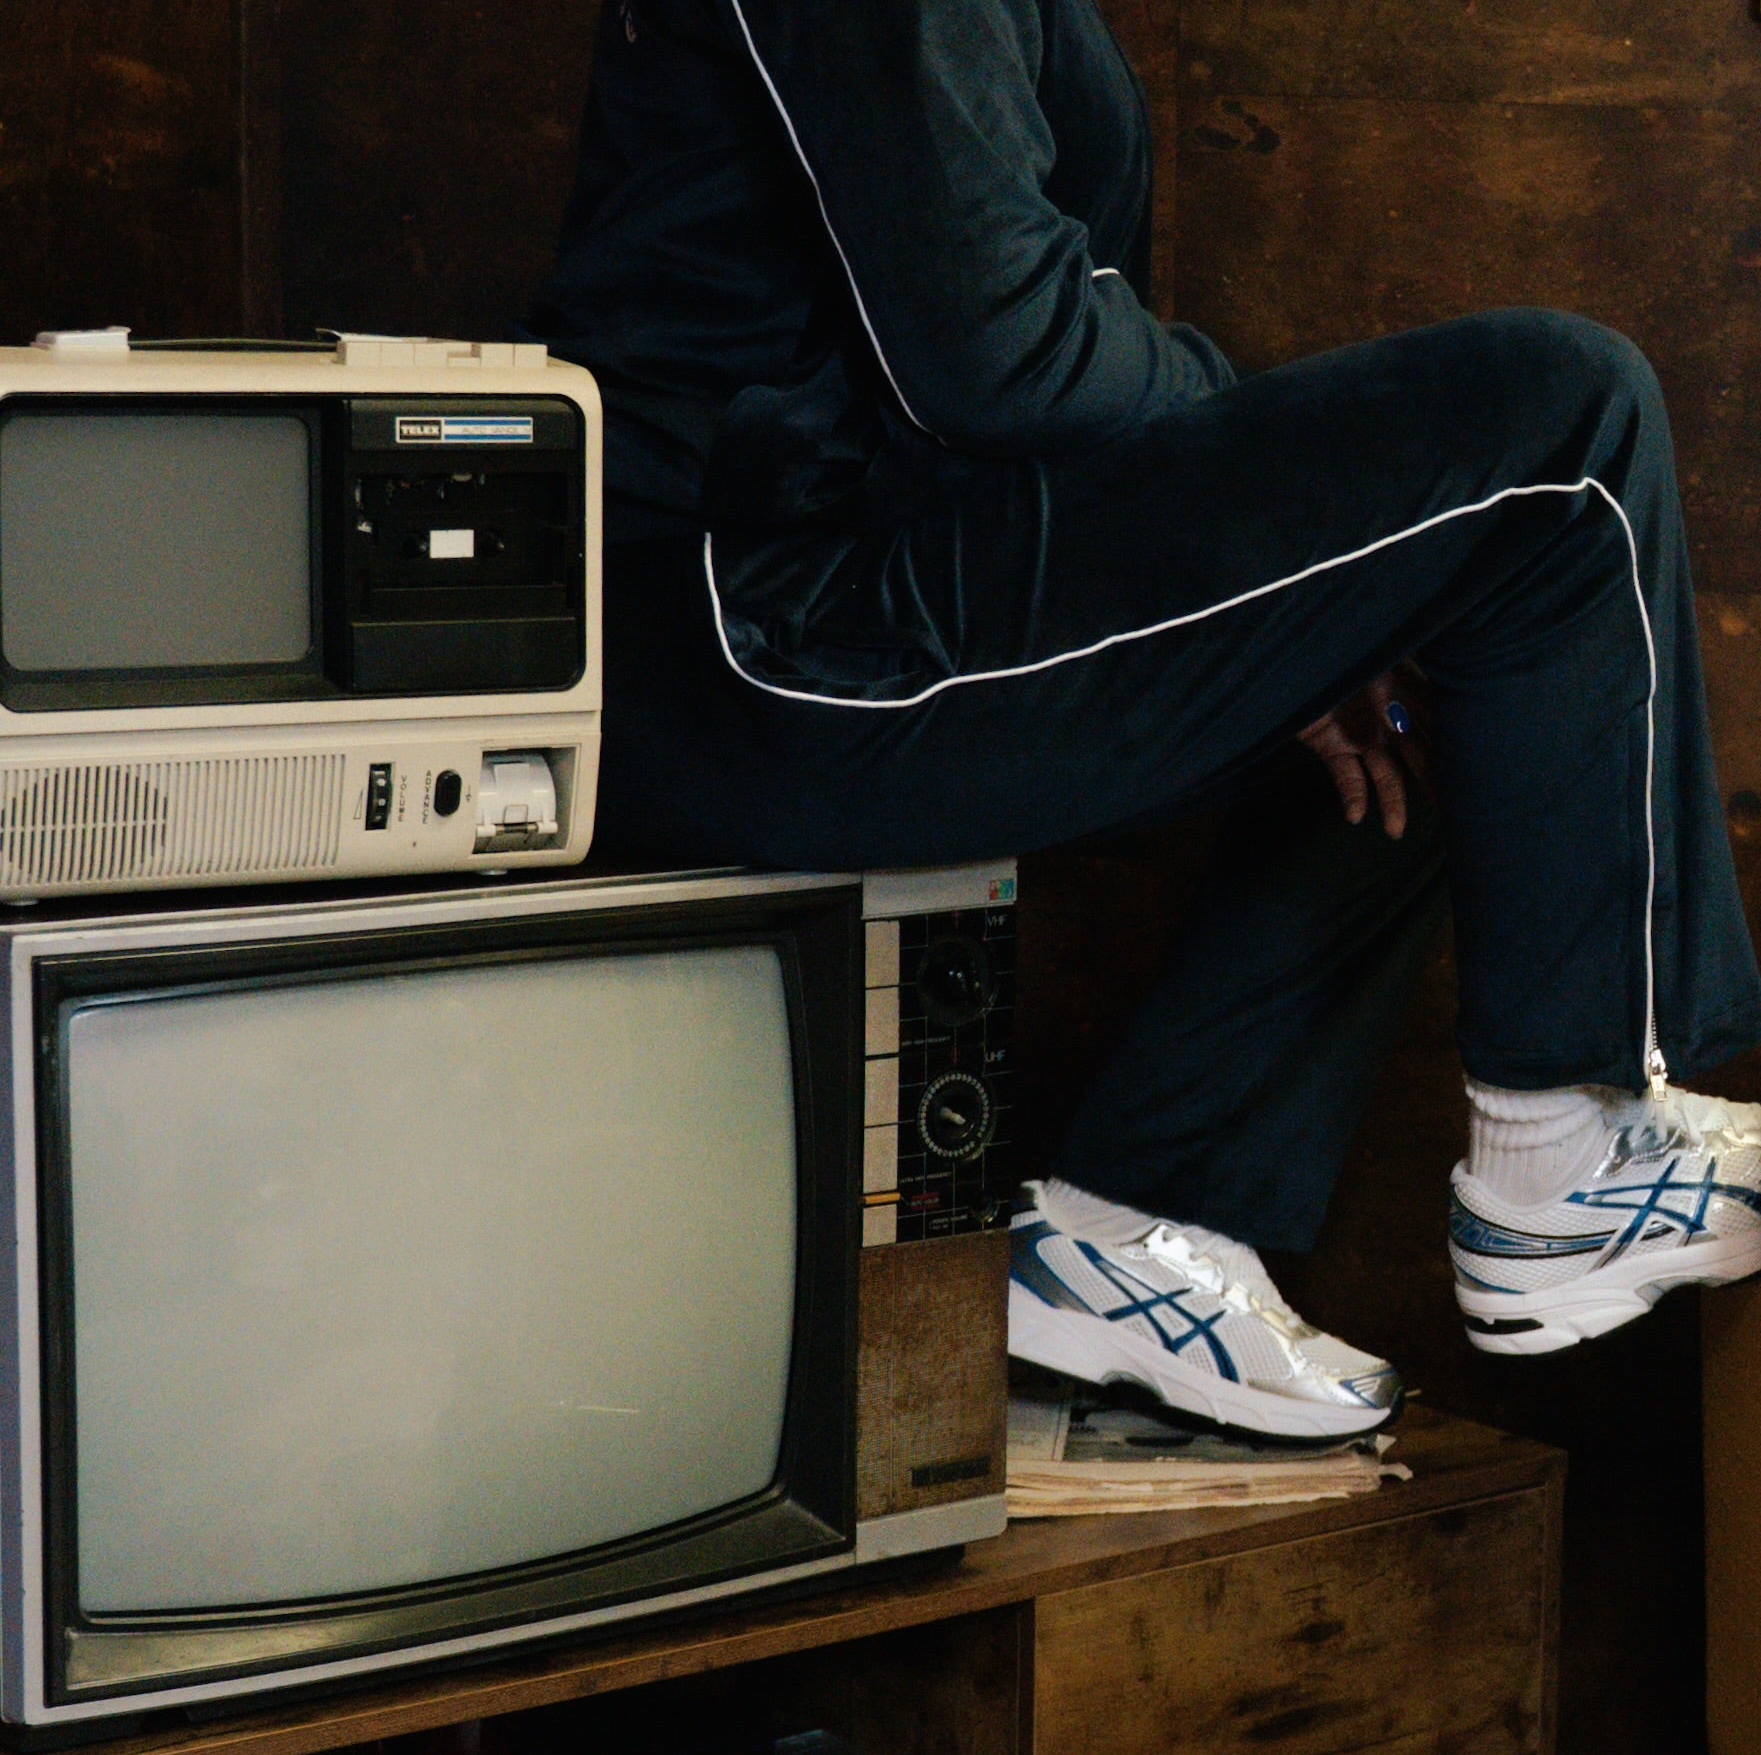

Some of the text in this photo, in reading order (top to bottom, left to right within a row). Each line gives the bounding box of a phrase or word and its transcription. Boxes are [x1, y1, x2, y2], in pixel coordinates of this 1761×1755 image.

[401, 424, 441, 436] TELEX
[398, 774, 408, 823] VOLUME
[422, 770, 432, 825] ADVANCE
